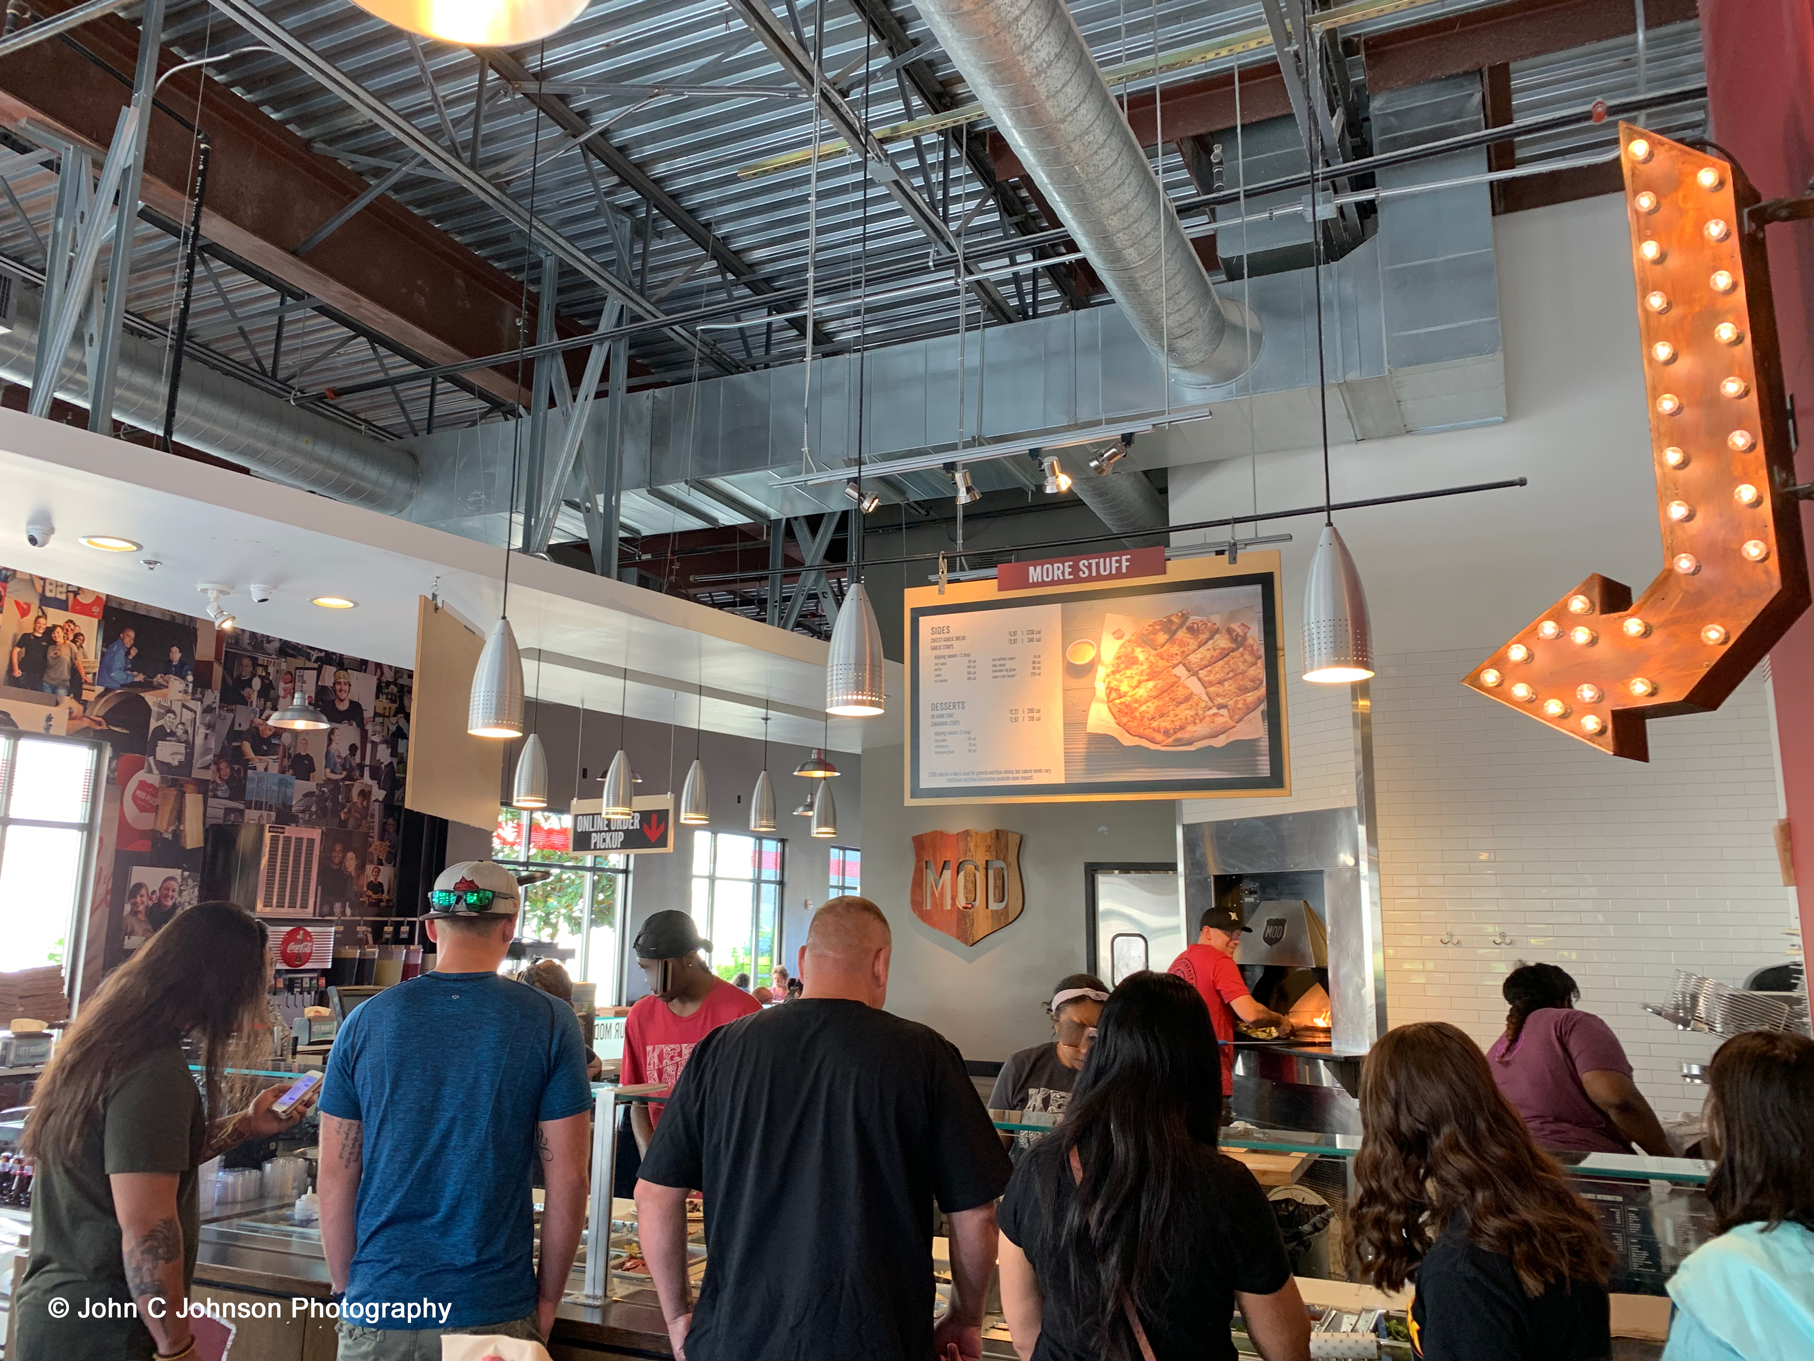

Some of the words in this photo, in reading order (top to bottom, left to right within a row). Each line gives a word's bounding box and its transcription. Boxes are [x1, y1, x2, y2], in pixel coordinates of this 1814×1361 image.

[1028, 561, 1074, 583] MORE
[1078, 555, 1131, 578] STUFF
[930, 626, 950, 635] SIDES
[931, 701, 966, 712] DESSERTS
[576, 814, 608, 832] ONLINE
[590, 832, 625, 849] PICKUP
[923, 859, 1008, 910] MOD
[1264, 927, 1283, 939] MOD
